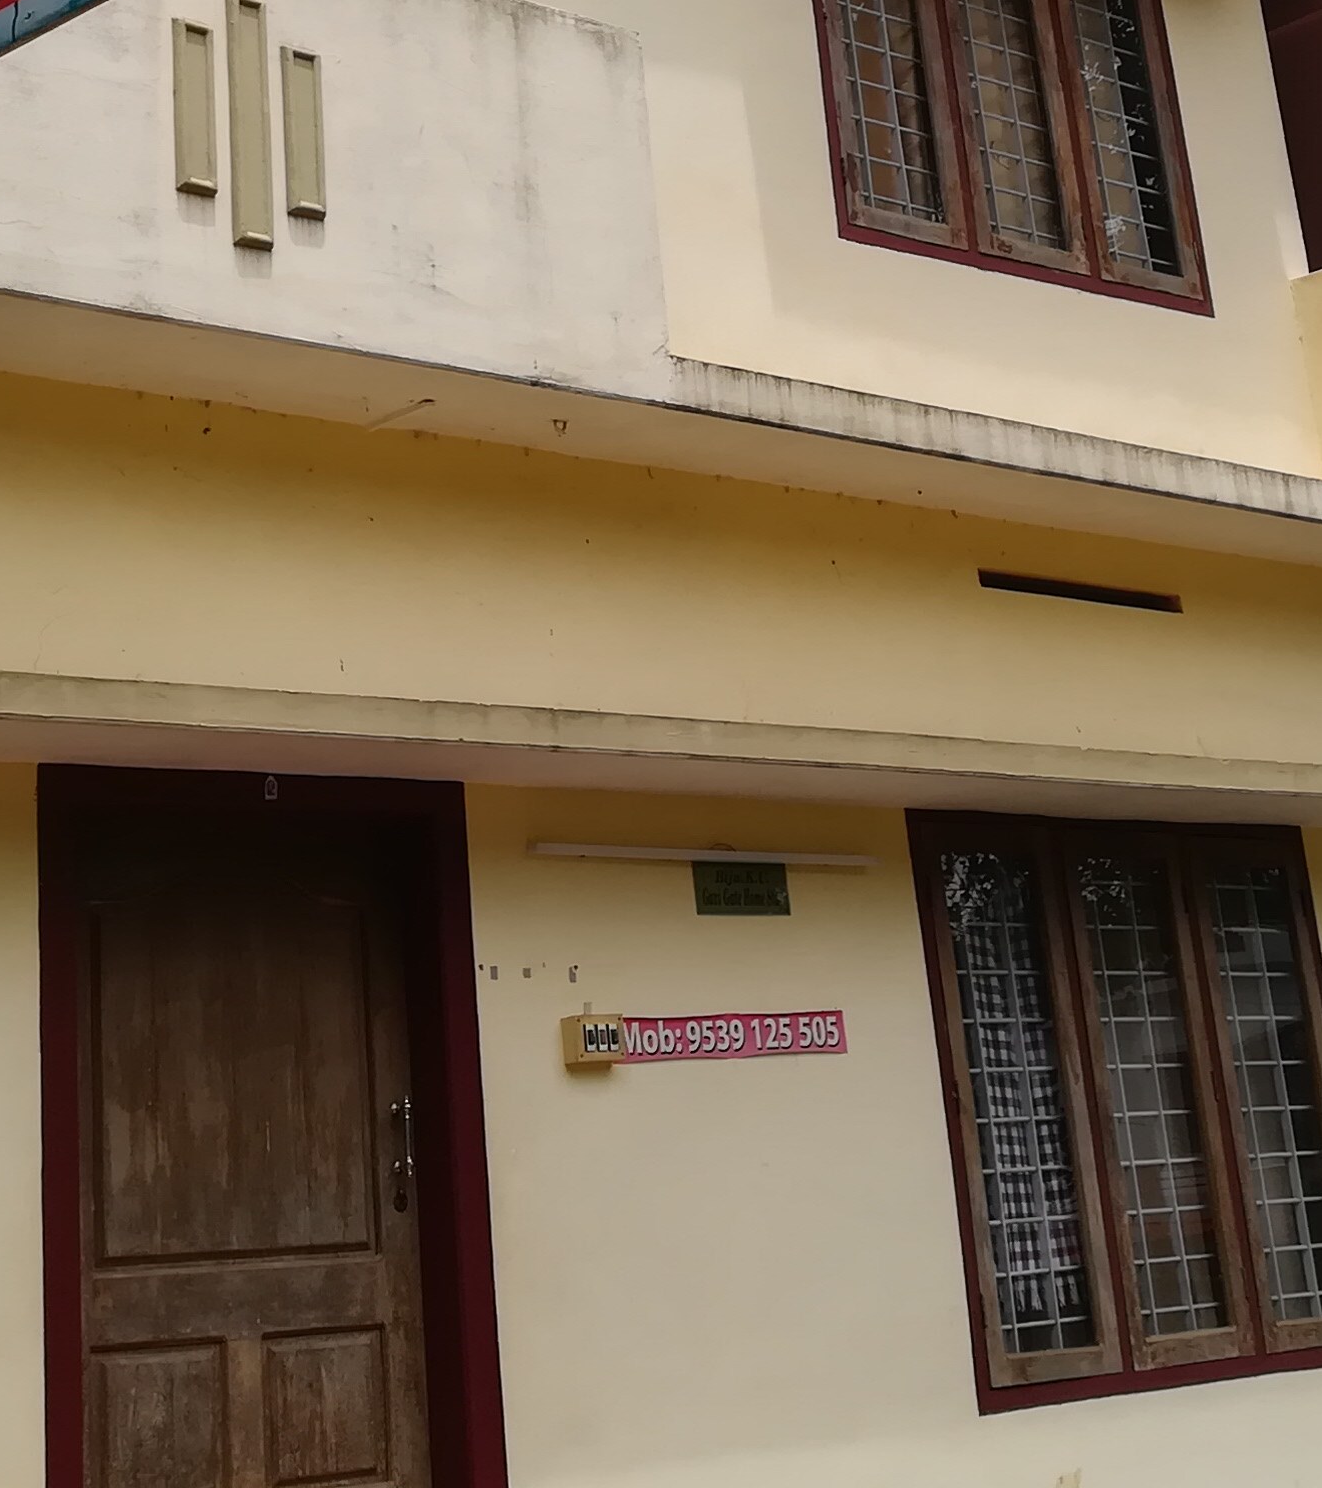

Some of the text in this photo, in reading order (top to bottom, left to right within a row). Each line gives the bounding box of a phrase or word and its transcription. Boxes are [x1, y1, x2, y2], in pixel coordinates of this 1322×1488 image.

[685, 1019, 745, 1053] 9539
[750, 1017, 793, 1051] 125
[798, 1015, 841, 1049] 505
